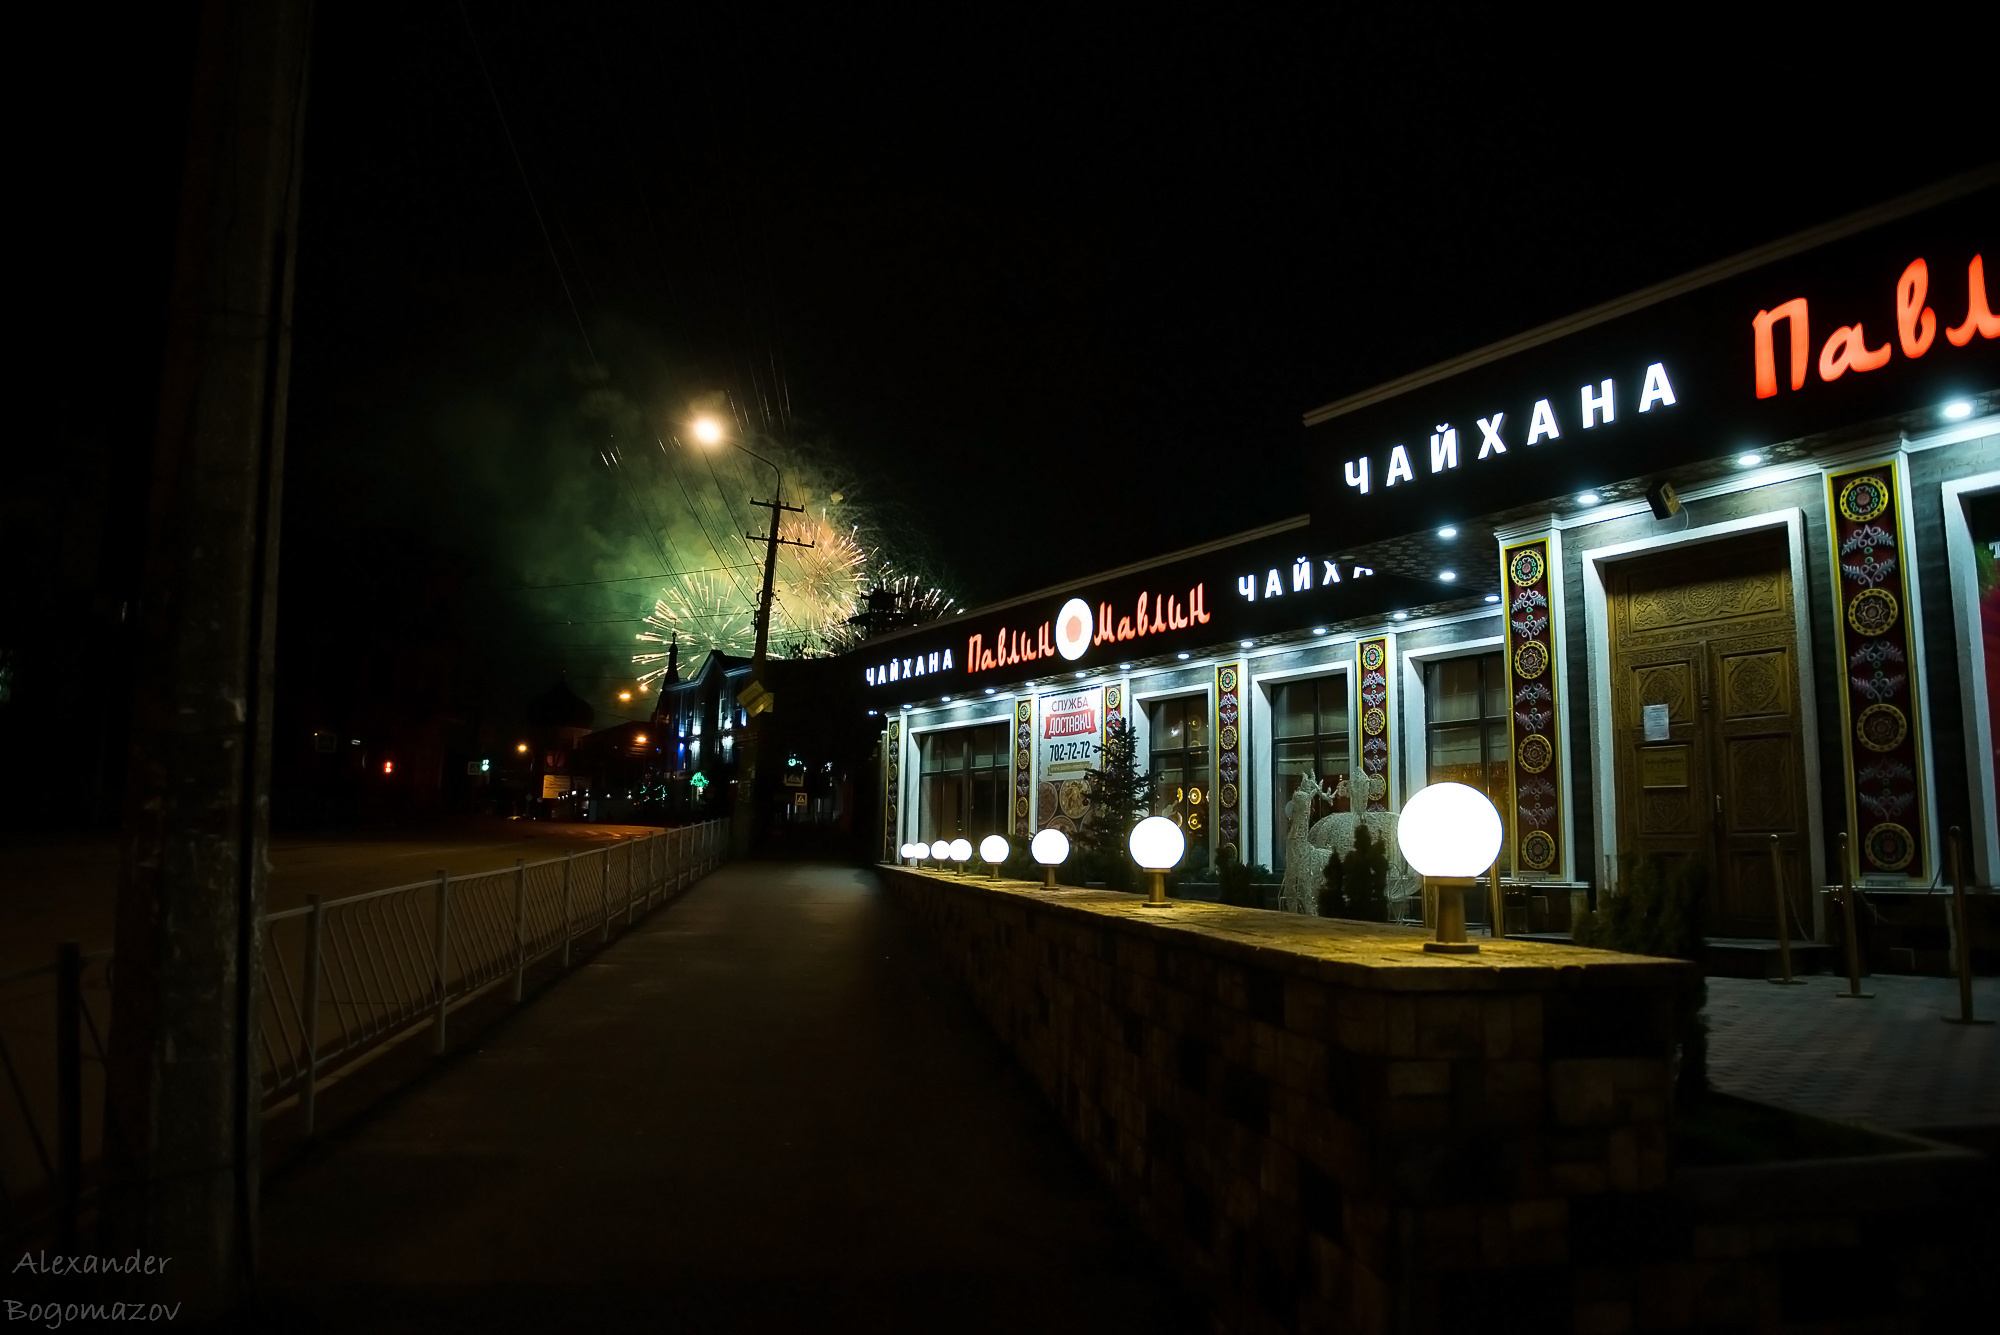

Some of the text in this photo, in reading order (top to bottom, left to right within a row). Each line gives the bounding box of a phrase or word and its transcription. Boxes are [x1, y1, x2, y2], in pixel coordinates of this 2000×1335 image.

[1344, 361, 1676, 494] ЧАЙХАНА
[865, 648, 953, 687] ЧАЙХАНА
[967, 620, 1055, 673] Павлин
[1093, 582, 1211, 646] Мавлин
[1052, 696, 1089, 712] СЛУЖБА
[1048, 711, 1092, 735] ДОСТАВКИ
[1049, 740, 1091, 762] 702-72-72
